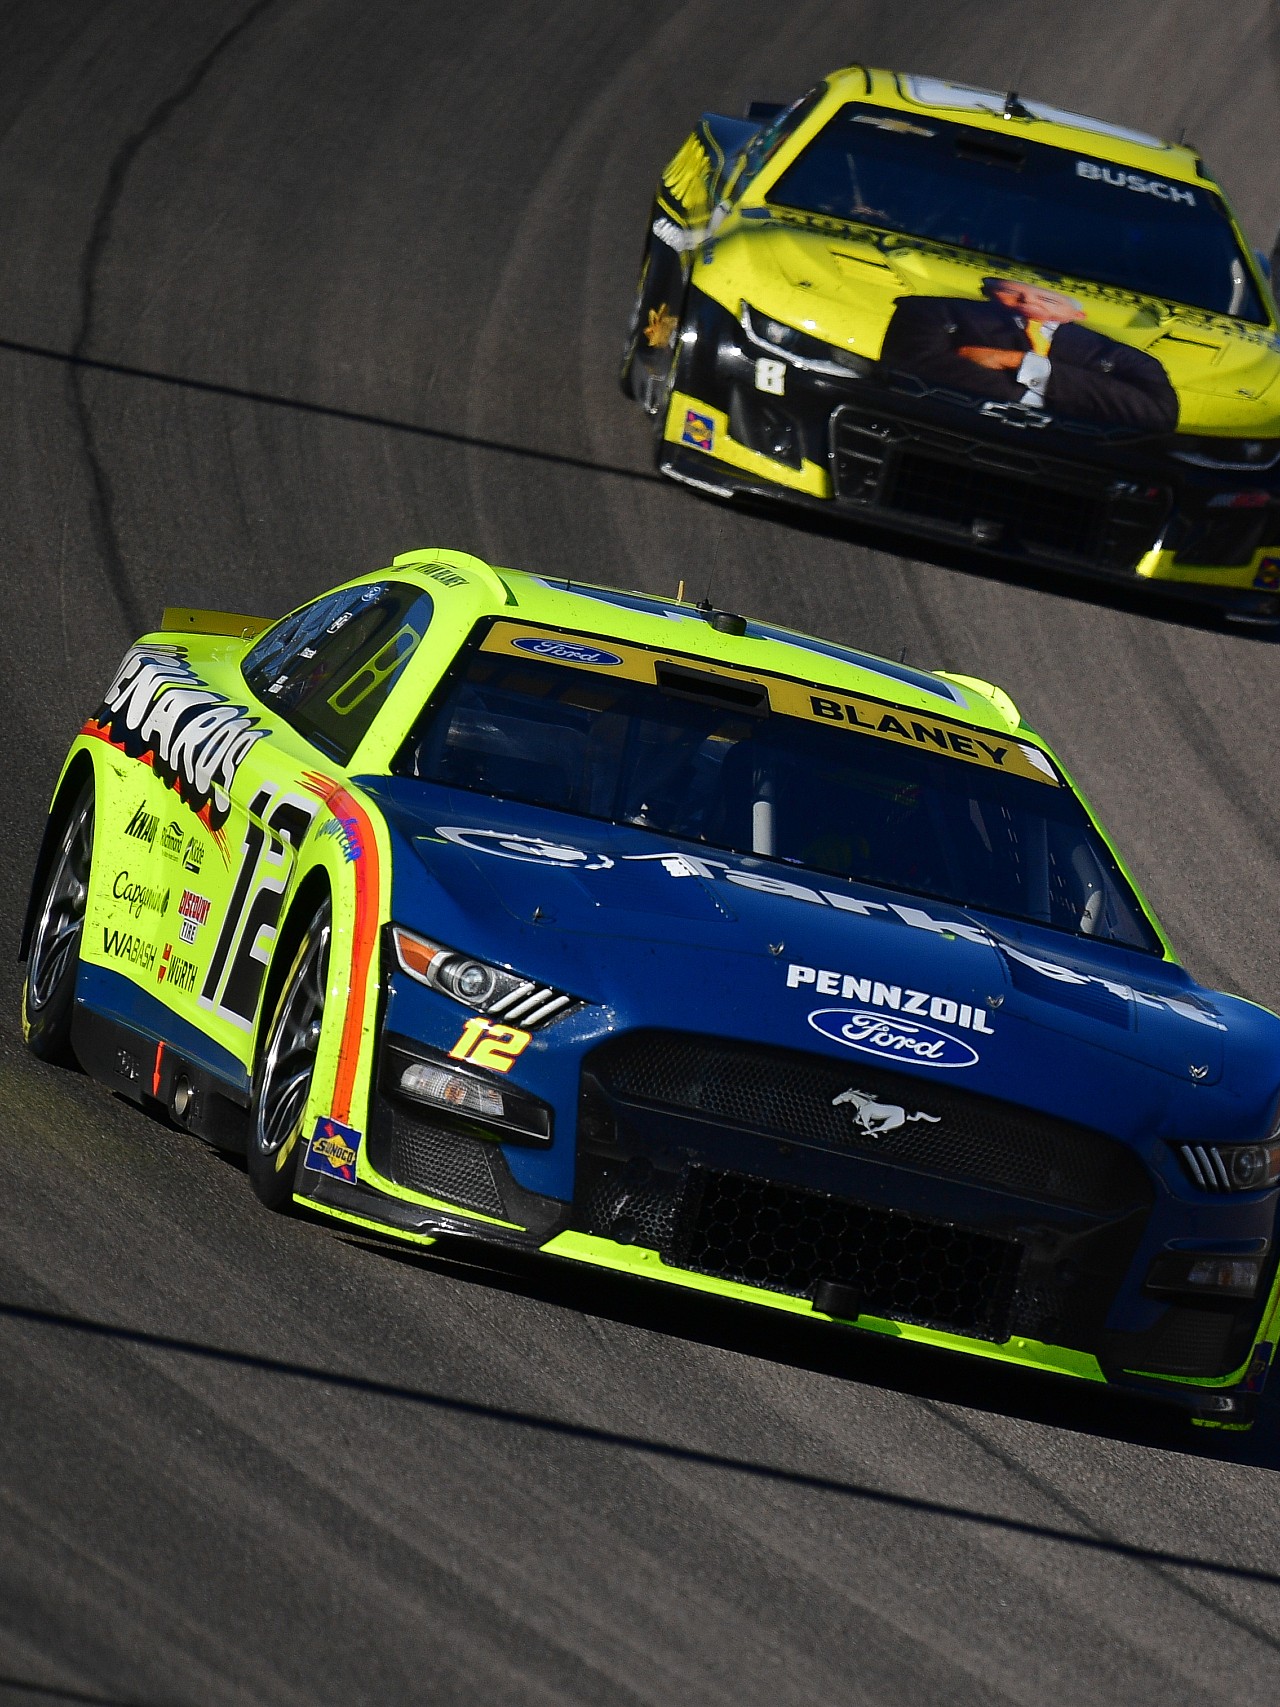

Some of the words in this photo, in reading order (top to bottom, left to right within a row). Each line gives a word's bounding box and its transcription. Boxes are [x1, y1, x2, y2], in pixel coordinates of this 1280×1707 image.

[1076, 161, 1197, 207] BUSCH
[755, 357, 787, 396] 8
[533, 641, 600, 662] Ford
[809, 695, 1008, 766] BLANEY
[199, 783, 317, 1036] 12
[103, 926, 158, 972] WABASH
[786, 963, 995, 1035] PENNZOIL
[447, 1016, 533, 1074] 12
[842, 1014, 946, 1059] Ford
